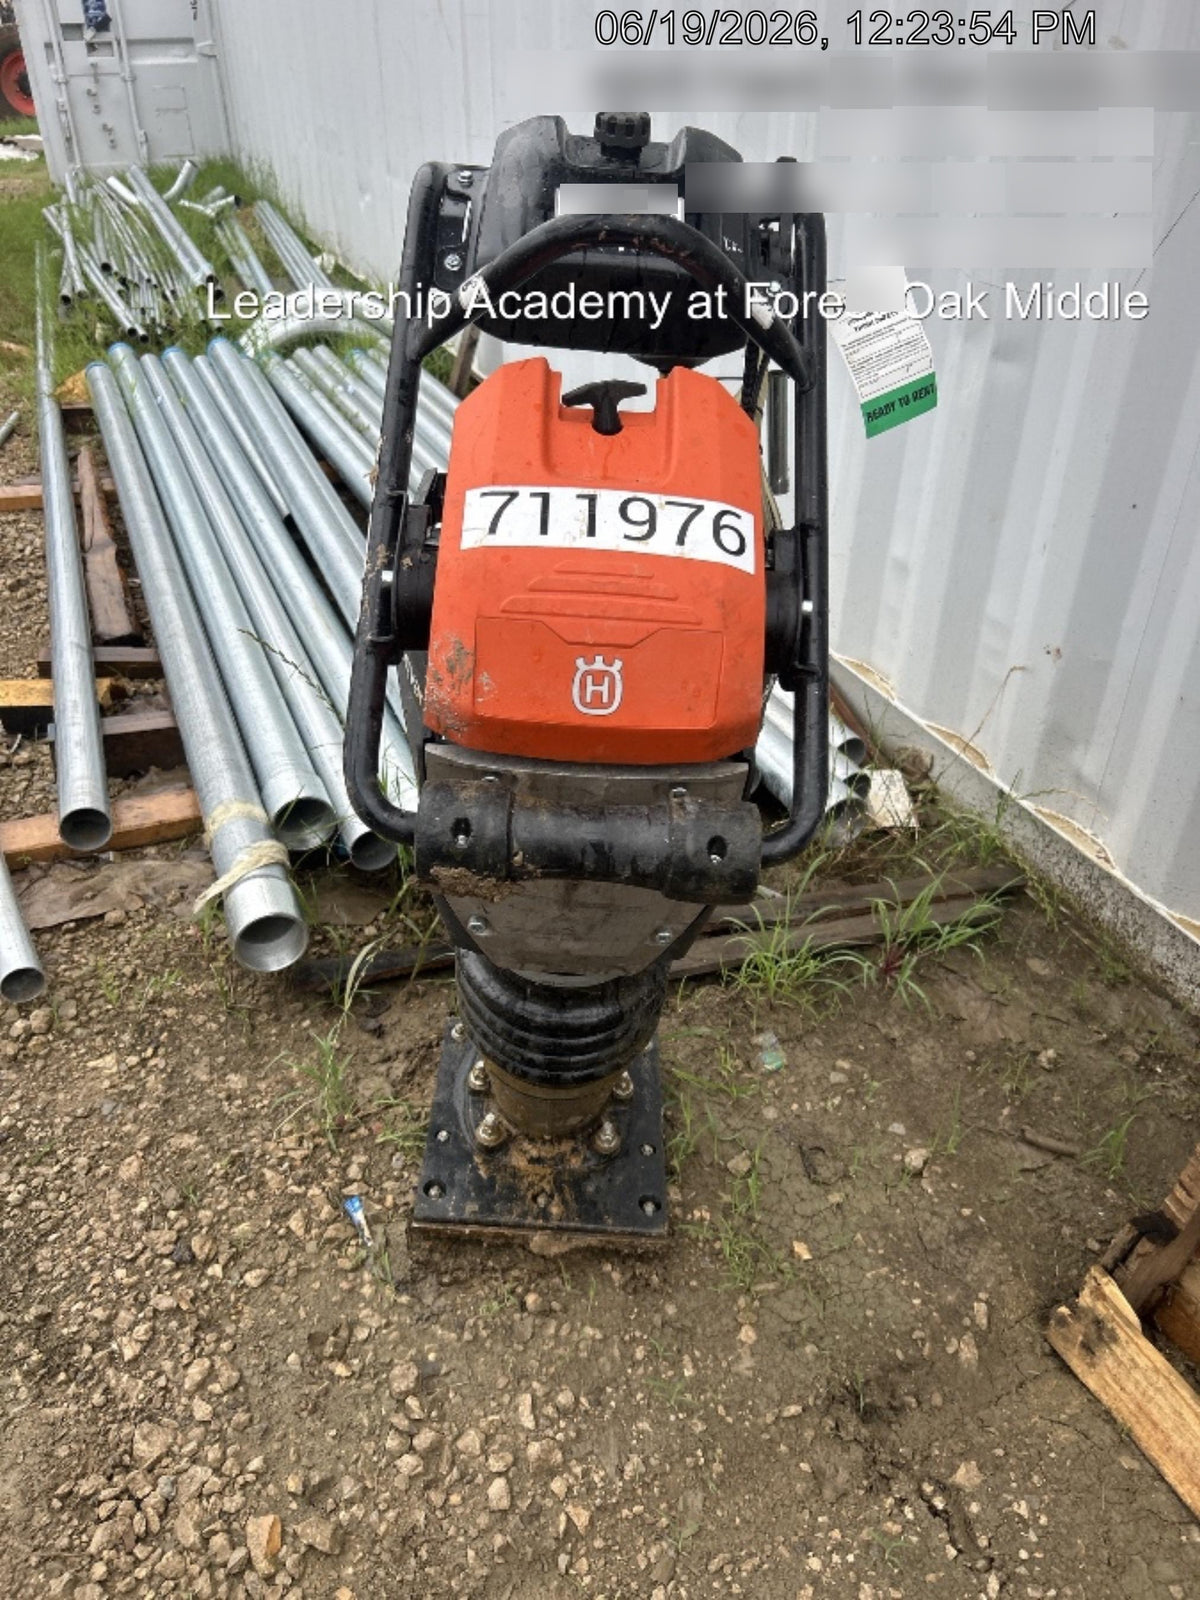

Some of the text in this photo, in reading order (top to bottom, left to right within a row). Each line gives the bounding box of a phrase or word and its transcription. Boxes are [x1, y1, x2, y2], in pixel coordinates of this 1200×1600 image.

[866, 383, 935, 424] READY TO RENT
[479, 490, 747, 557] 711976
